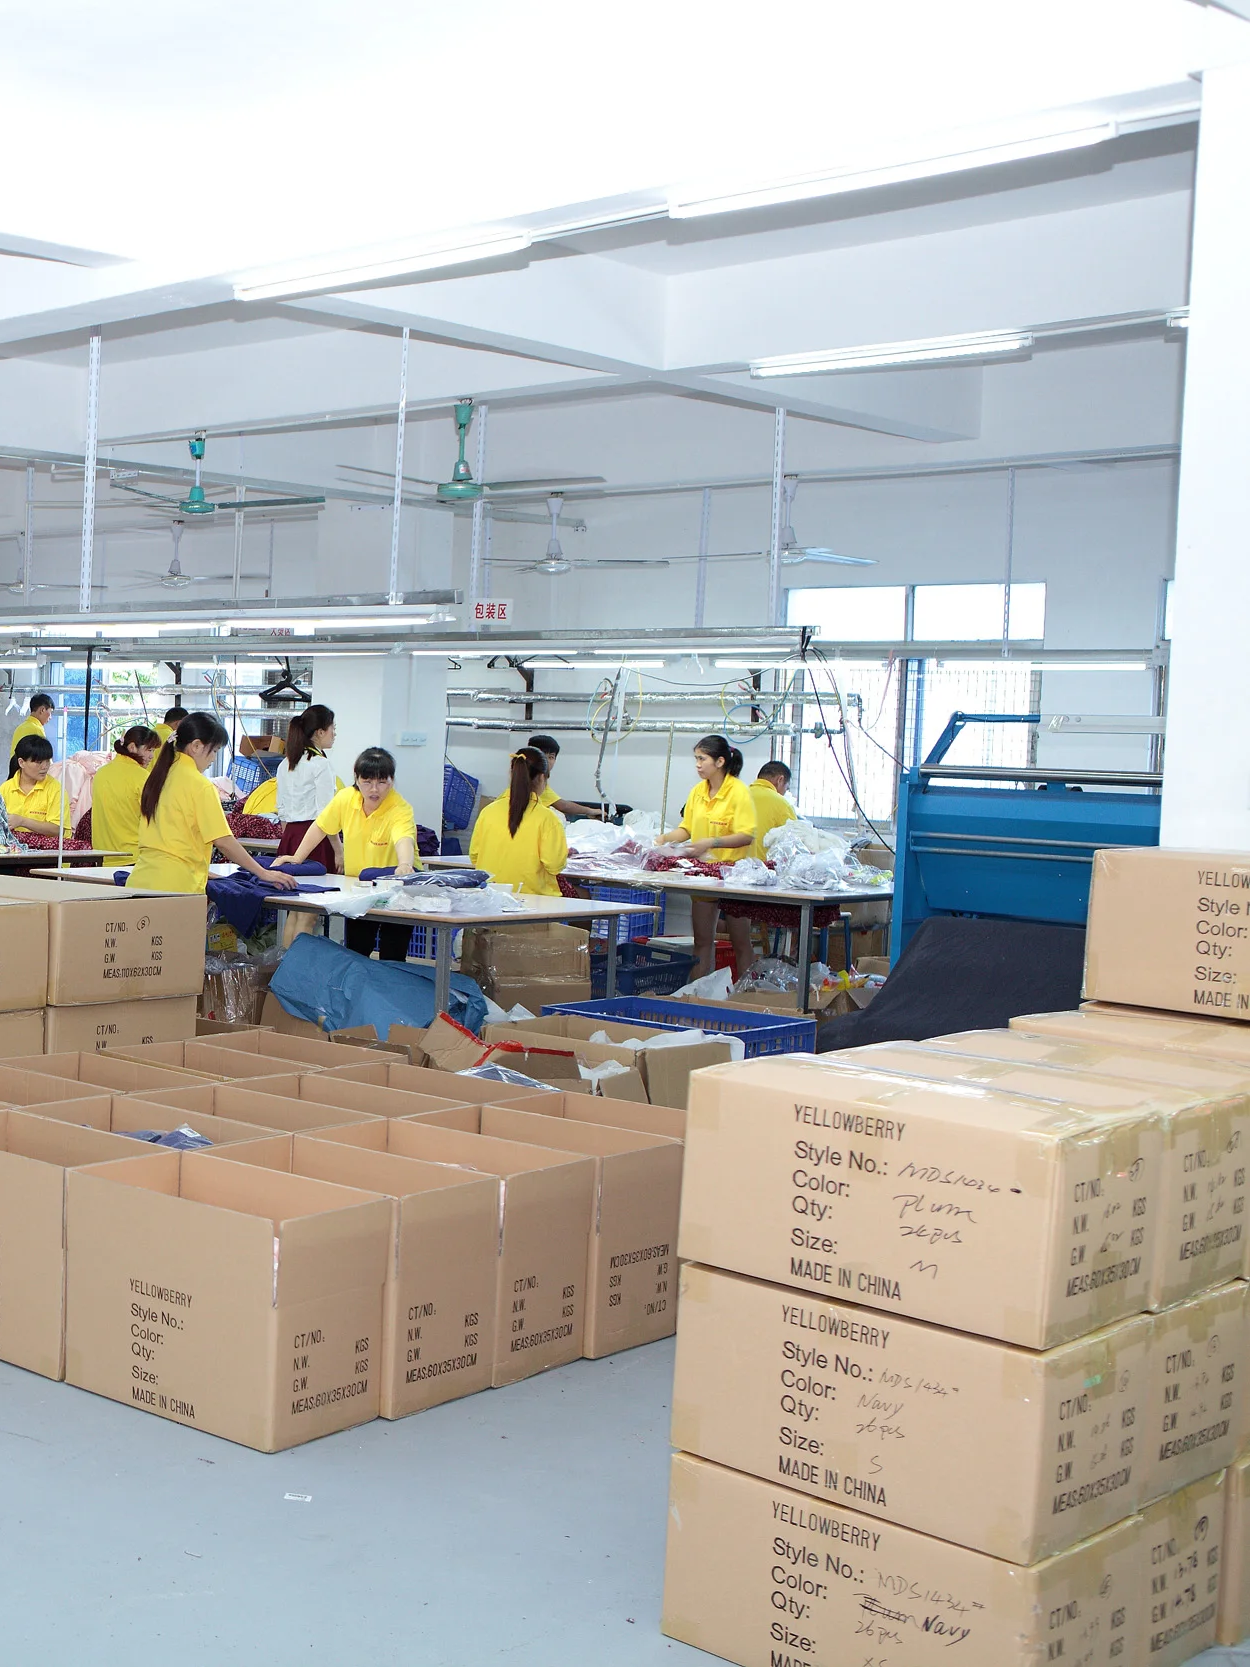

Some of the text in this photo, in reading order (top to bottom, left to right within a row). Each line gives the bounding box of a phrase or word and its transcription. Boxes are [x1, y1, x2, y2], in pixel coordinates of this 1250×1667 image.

[475, 602, 507, 620] 包装区
[1197, 897, 1240, 916] Style
[106, 922, 128, 932] CT/NO:
[1196, 920, 1248, 938] Color:
[104, 936, 162, 948] N.W. KGS
[1196, 940, 1232, 959] Qty:
[104, 951, 162, 964] G.W. KGS
[1194, 966, 1237, 984] Size:
[1194, 990, 1249, 1010] MADE IN
[96, 1024, 119, 1035] CT/NO:
[794, 1104, 906, 1141] YELLOWBERRY
[794, 1140, 888, 1176] Style No.:
[792, 1169, 850, 1197] Color:
[792, 1195, 832, 1222] Qty:
[791, 1228, 838, 1254] Size:
[514, 1276, 539, 1293] CT/NO:
[609, 1262, 668, 1288] G.W. KGS
[791, 1257, 902, 1301] MADE IN CHINA
[130, 1278, 192, 1308] YELLOWBERRY
[512, 1284, 574, 1314] N.W. KGS
[609, 1281, 668, 1307] N.W. KGS
[130, 1303, 184, 1330] Style No.:
[408, 1303, 436, 1320] CT/NO:
[512, 1304, 574, 1332] G.W. KGS
[131, 1324, 164, 1345] Color:
[294, 1330, 325, 1349] CT/NO:
[408, 1312, 478, 1342] N.W. KGS
[782, 1304, 890, 1349] YELLOWBERRY
[132, 1342, 154, 1362] Qty:
[294, 1338, 370, 1372] N.W. KGS
[407, 1333, 478, 1363] G.W. KGS
[782, 1341, 874, 1382] Style No.:
[132, 1365, 158, 1386] Size:
[292, 1358, 368, 1393] G.W. KGS
[781, 1370, 836, 1400] Color:
[132, 1386, 196, 1420] MADE IN CHINA
[780, 1394, 819, 1422] Qty:
[779, 1426, 824, 1456] Size:
[779, 1455, 887, 1506] MADE IN CHINA
[772, 1500, 880, 1551] YELLOWBERRY
[772, 1537, 864, 1583] Style No.:
[771, 1566, 828, 1600] Color:
[771, 1591, 810, 1620] Qty:
[770, 1622, 816, 1654] Size:
[922, 1615, 970, 1646] Navy
